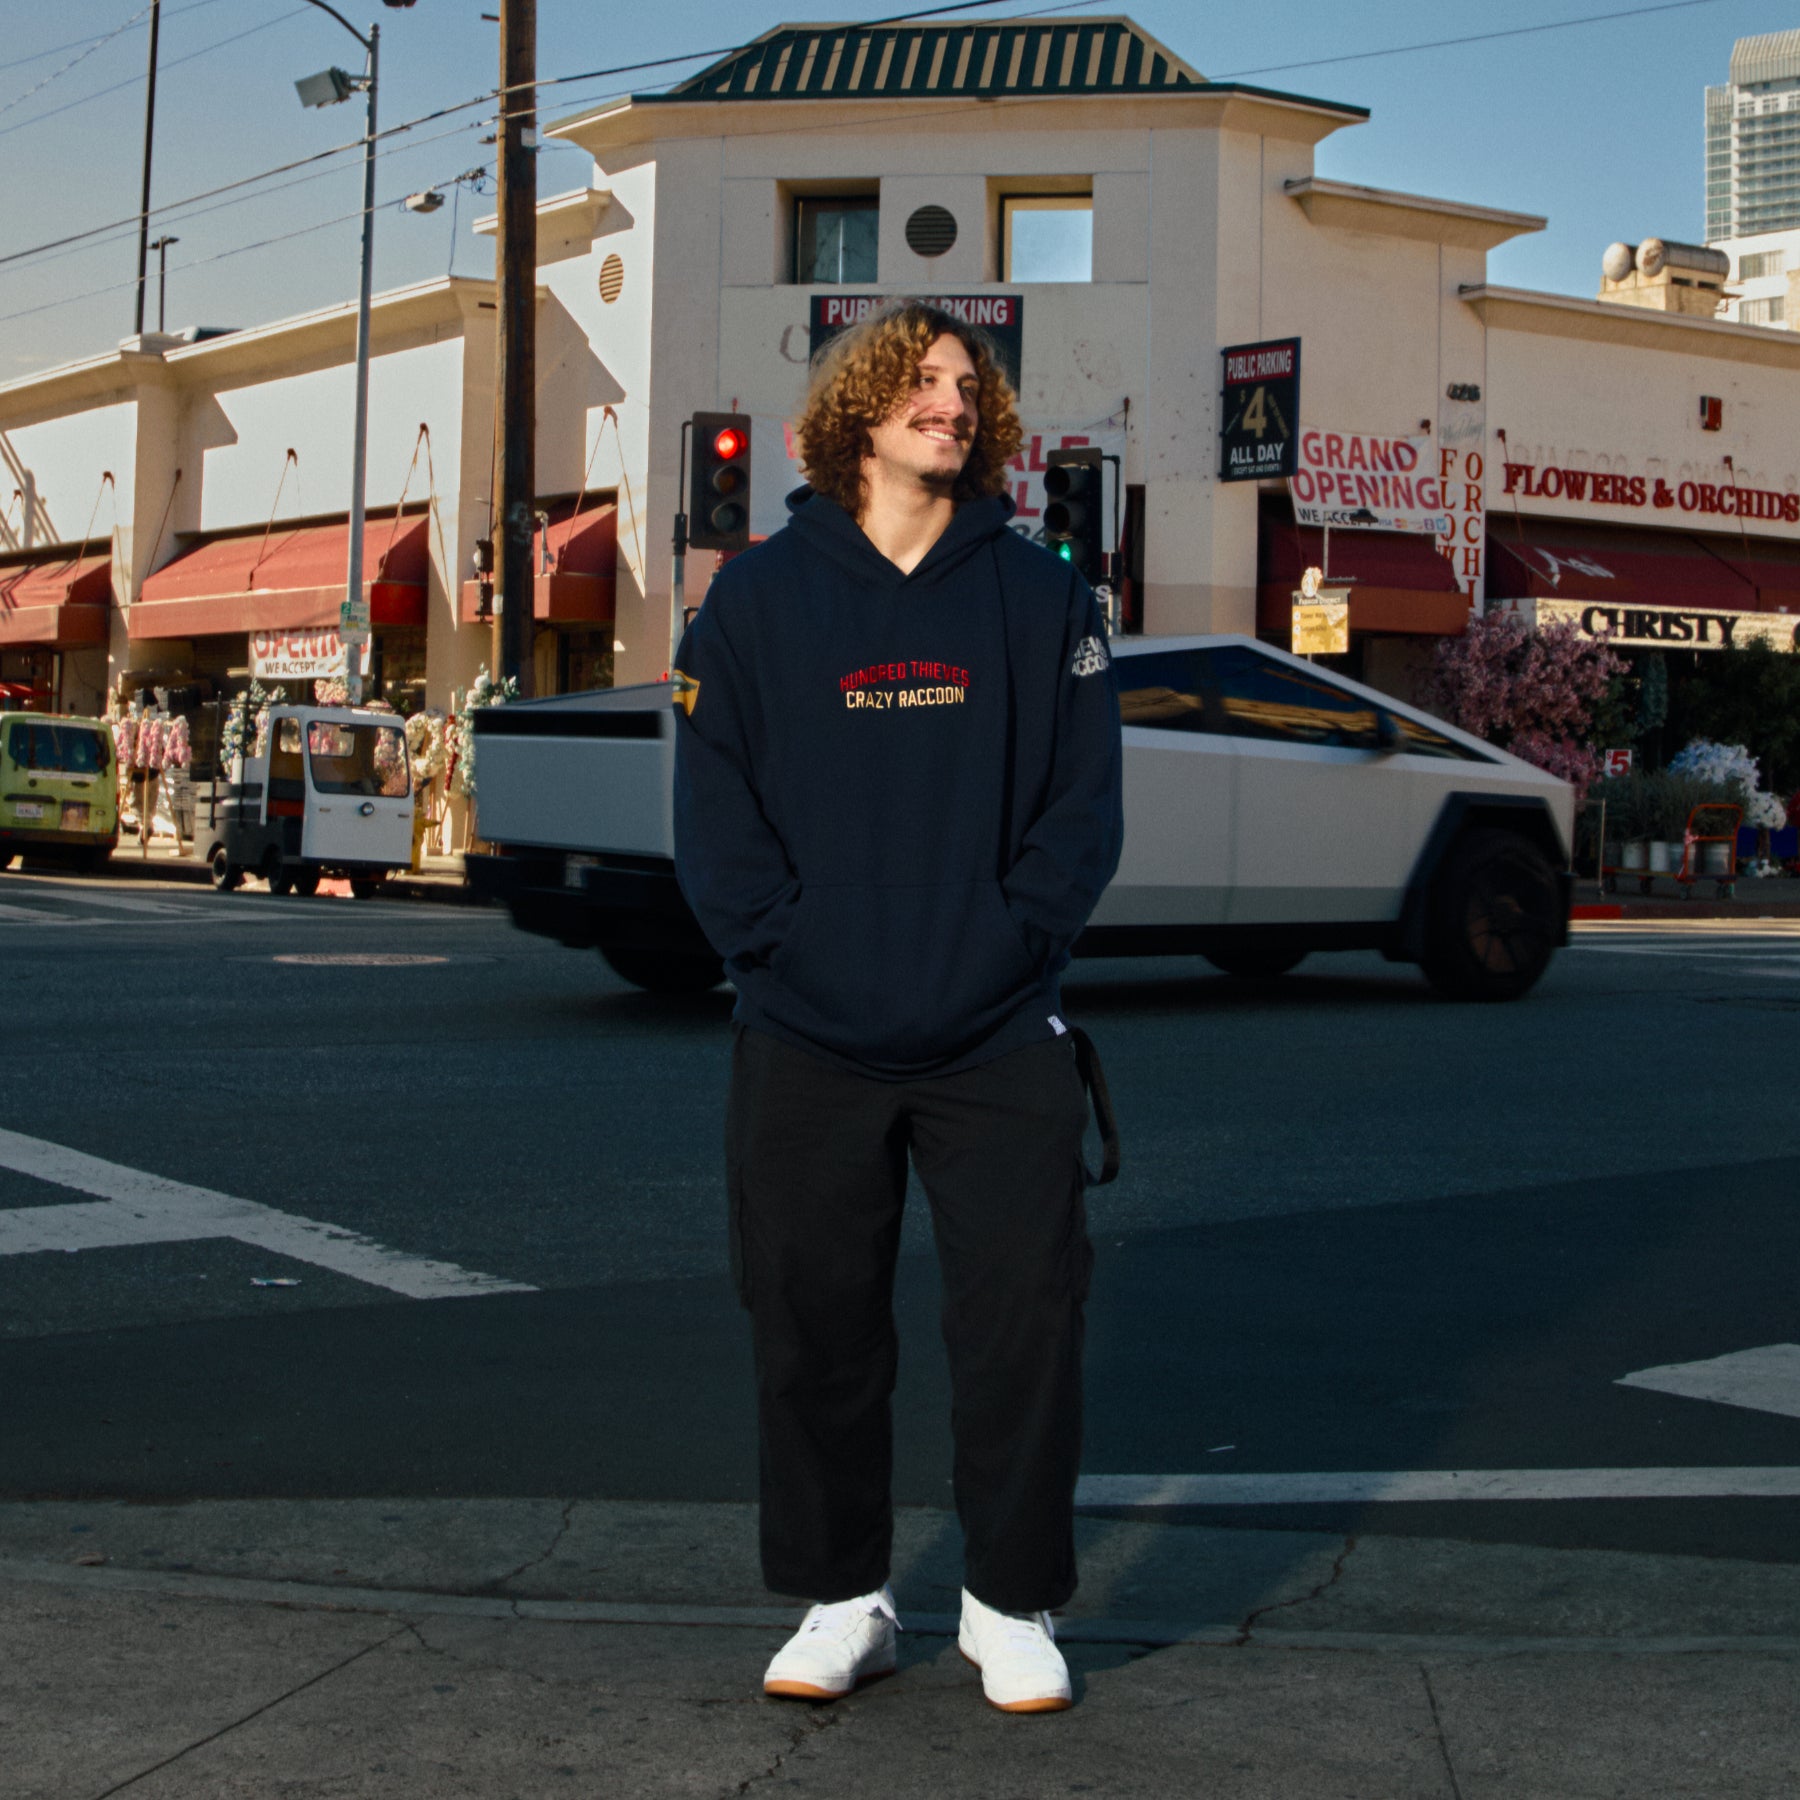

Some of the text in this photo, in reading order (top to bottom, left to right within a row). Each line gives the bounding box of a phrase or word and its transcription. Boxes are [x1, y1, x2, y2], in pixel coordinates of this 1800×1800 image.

[1227, 349, 1292, 380] PUBLIC PARKING
[1229, 442, 1285, 465] ALL DAY
[1302, 432, 1418, 473] GRAND
[1292, 467, 1442, 511] OPENING
[1503, 462, 1647, 507] FLOWERS
[1652, 478, 1675, 509] &
[1678, 481, 1800, 523] ORCHIDS
[1298, 507, 1320, 523] WE
[1581, 606, 1740, 645] CHRISTY
[265, 661, 317, 674] WE ACCEPT
[840, 660, 970, 692] HUNDRED THIEVES
[846, 686, 964, 709] CRAZY RACCOON
[1606, 750, 1629, 776] $5
